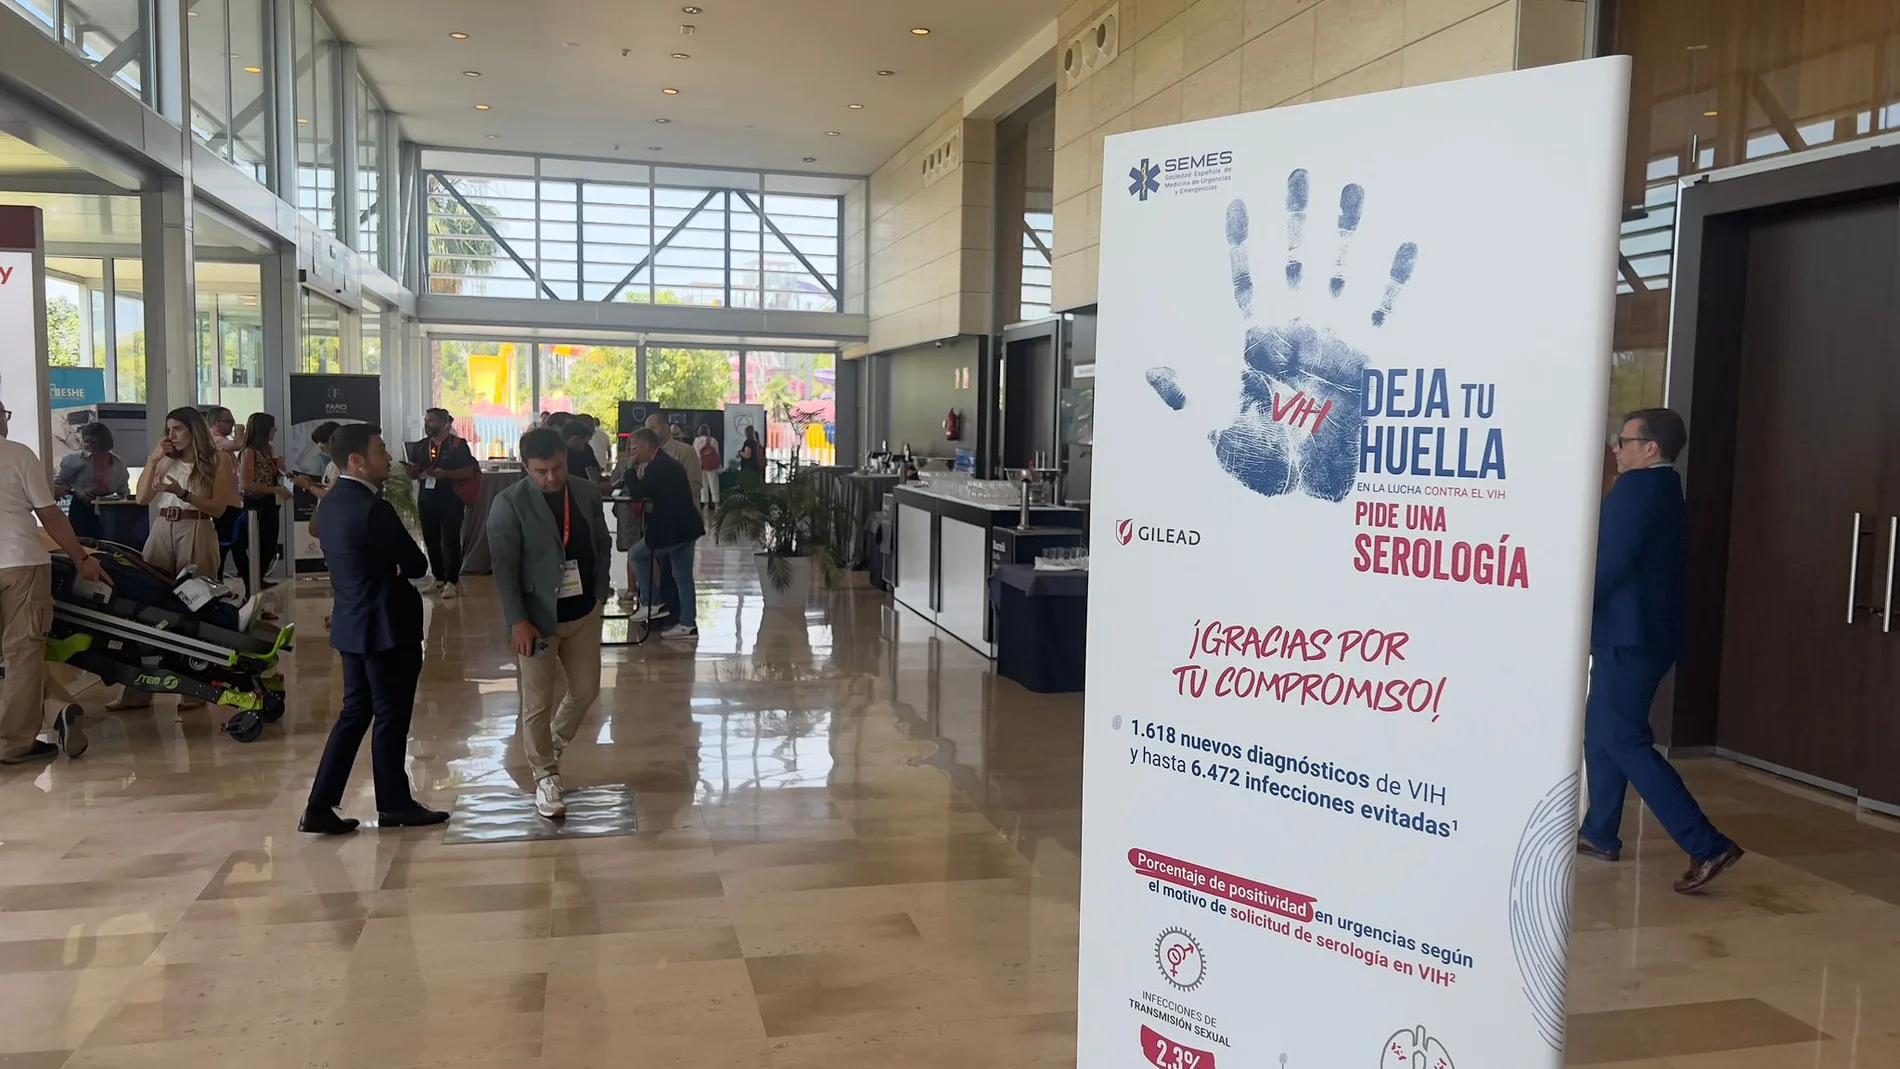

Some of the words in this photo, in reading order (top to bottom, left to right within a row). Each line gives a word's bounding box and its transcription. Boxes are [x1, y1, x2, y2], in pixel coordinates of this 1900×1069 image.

[1165, 151, 1232, 172] SEMES
[1165, 172, 1191, 181] Sociedad
[1194, 169, 1221, 178] Española
[1165, 181, 1190, 189] Medicina
[1201, 175, 1231, 185] Urgencias
[1180, 185, 1217, 195] Emergencias
[1272, 391, 1333, 434] VIH
[1360, 368, 1450, 418] DEJA
[1461, 384, 1495, 418] TU
[1359, 426, 1506, 480] HUELLA
[1357, 482, 1370, 492] EN
[1373, 483, 1385, 493] LA
[1388, 484, 1421, 496] LUCHA
[1424, 486, 1468, 498] CONTRA
[1471, 488, 1483, 499] EL
[1487, 489, 1506, 500] VIH
[1138, 526, 1201, 546] GILEAD
[1355, 501, 1399, 528] PIDE
[1406, 504, 1447, 532] UNA
[1354, 533, 1529, 589] SEROLOGÍA
[1189, 619, 1333, 662] ¡GRACIAS
[1337, 628, 1409, 666] POR
[1172, 665, 1208, 698] TU
[1215, 666, 1447, 723] COMPROMISO!
[1130, 747, 1139, 765] y
[1143, 746, 1186, 774] hasta
[1191, 759, 1240, 787] 6.472
[1245, 771, 1355, 815] infecciones
[1132, 719, 1176, 744] 1.618
[1181, 733, 1242, 759] nuevos
[1247, 744, 1370, 789] diagnósticos
[1376, 773, 1401, 796] de
[1408, 779, 1446, 806] VIH
[1138, 852, 1206, 886] Porcentaje
[1209, 875, 1226, 892] de
[1229, 882, 1307, 917] positividad
[1315, 910, 1333, 926] en
[1337, 917, 1416, 951] urgencias
[1421, 942, 1473, 968] según
[1149, 879, 1160, 894] el
[1163, 884, 1207, 909] motivo
[1210, 898, 1227, 915] de
[1230, 906, 1290, 936] solicitud
[1294, 925, 1312, 943] de
[1316, 935, 1389, 968] serología
[1393, 960, 1413, 976] en
[1128, 998, 1192, 1032] TRANSMISIÓN
[1194, 1025, 1232, 1048] SEXUAL
[1142, 990, 1202, 1022] INFECCIONES
[1204, 1015, 1217, 1028] DE
